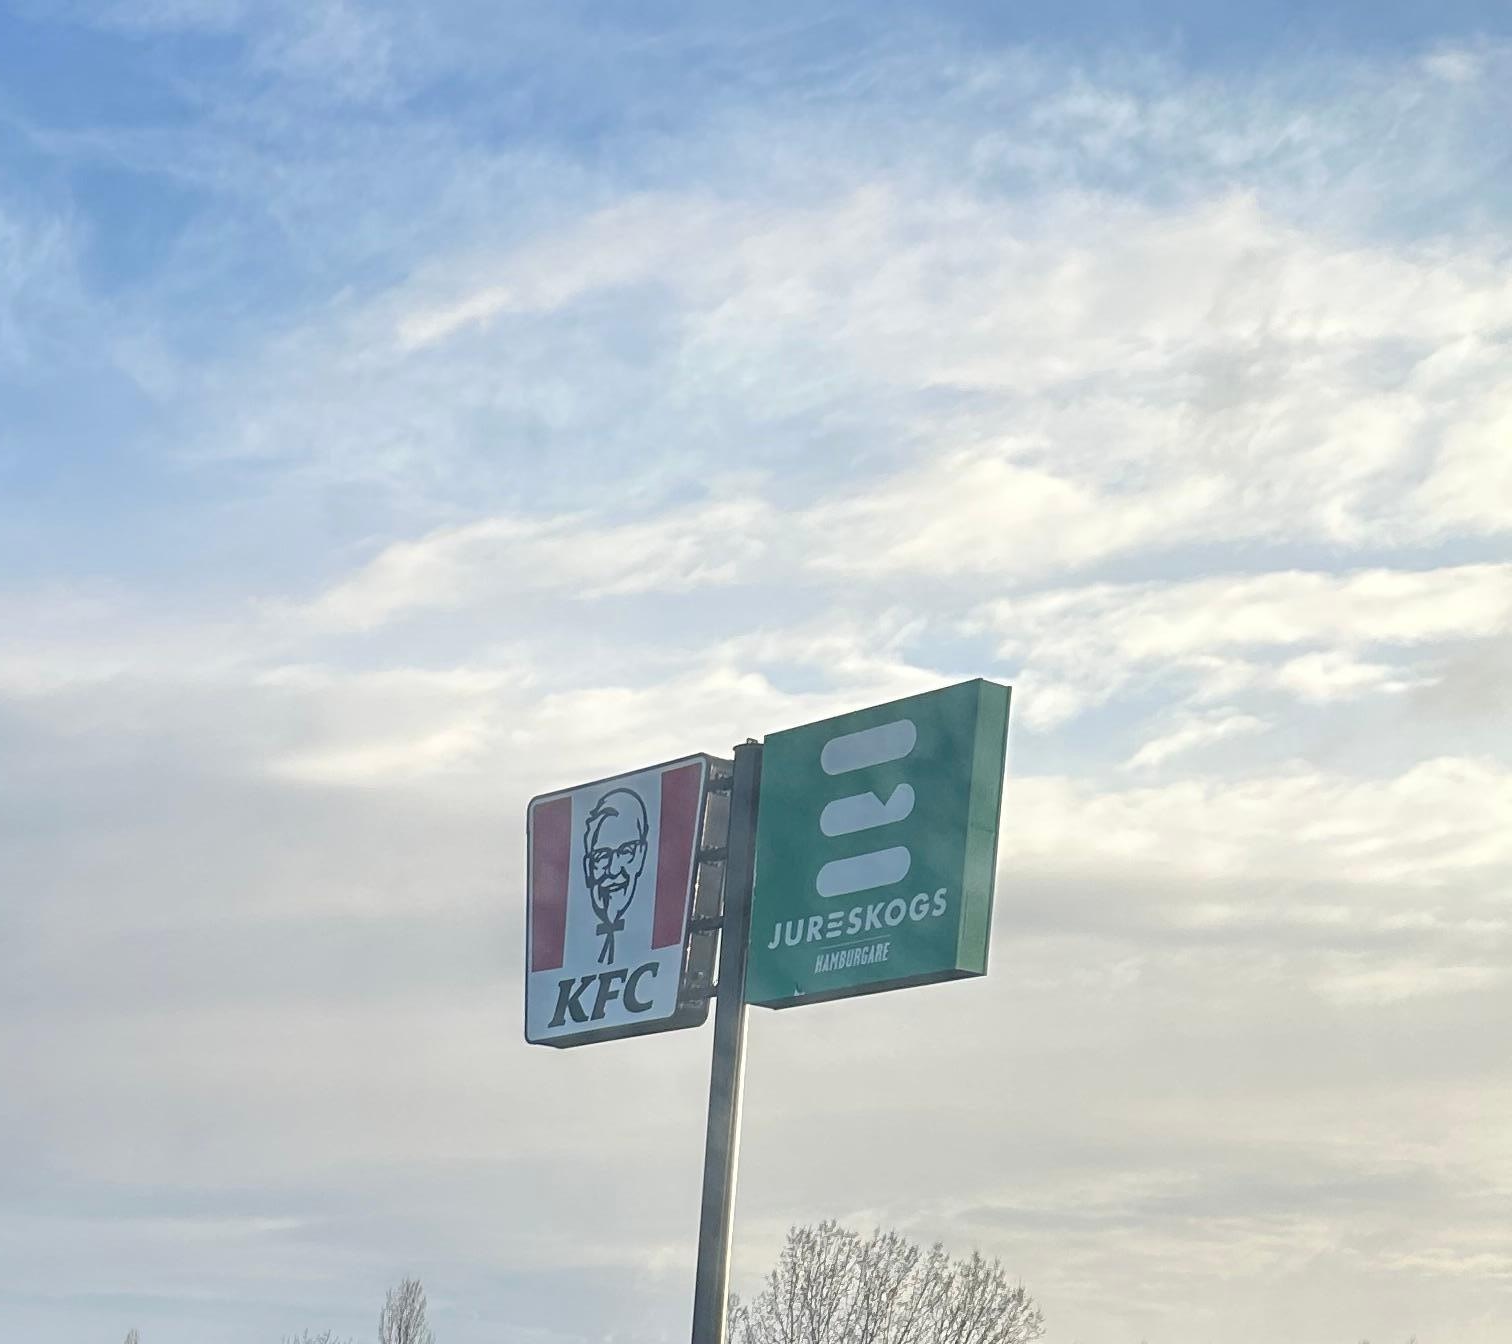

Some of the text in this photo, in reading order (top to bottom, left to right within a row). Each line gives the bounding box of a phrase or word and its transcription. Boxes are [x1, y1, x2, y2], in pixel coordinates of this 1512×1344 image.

[768, 888, 948, 950] JURESKOGS
[815, 942, 891, 974] HAMBURGARE
[548, 962, 660, 1028] KFC
